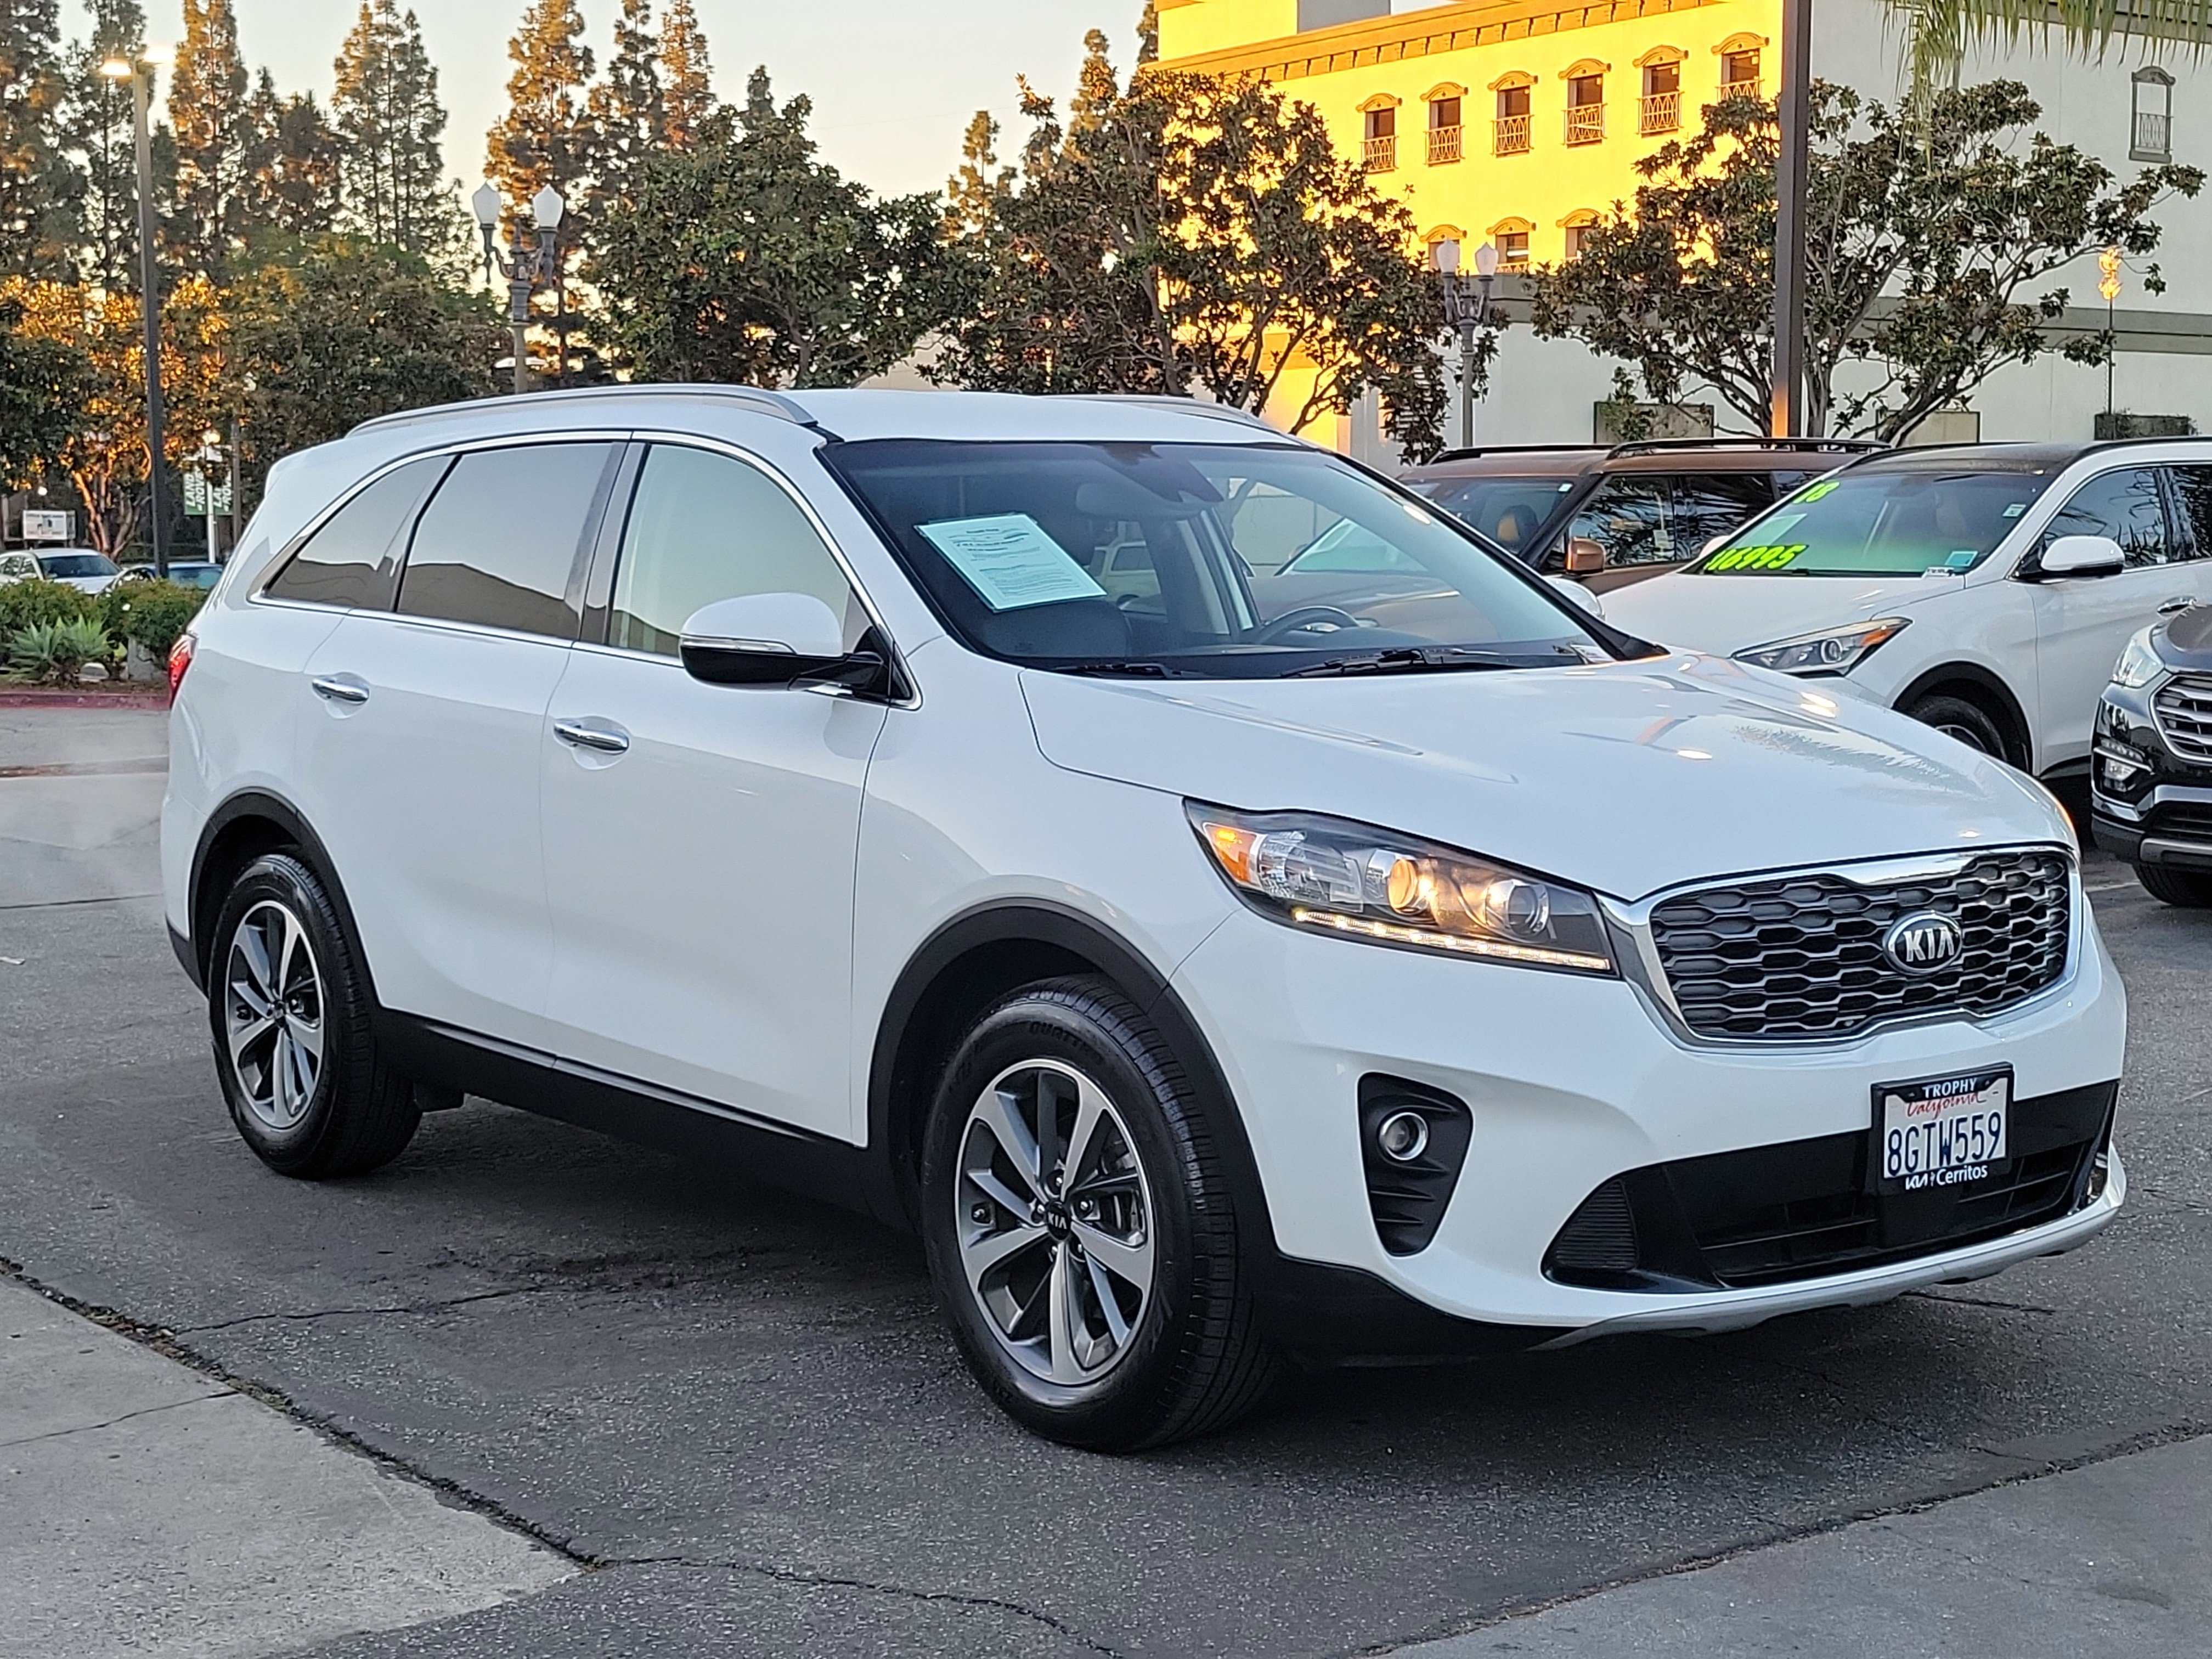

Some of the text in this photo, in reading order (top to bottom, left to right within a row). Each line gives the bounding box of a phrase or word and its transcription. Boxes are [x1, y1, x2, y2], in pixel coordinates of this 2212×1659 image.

[185, 473, 195, 507] LAND
[1903, 927, 1954, 962] KIA
[1922, 1077, 1976, 1098] TROPHY
[1887, 1111, 2001, 1177] 8GTW559
[1936, 1165, 1988, 1186] Cerritos
[1048, 1211, 1067, 1229] KIA
